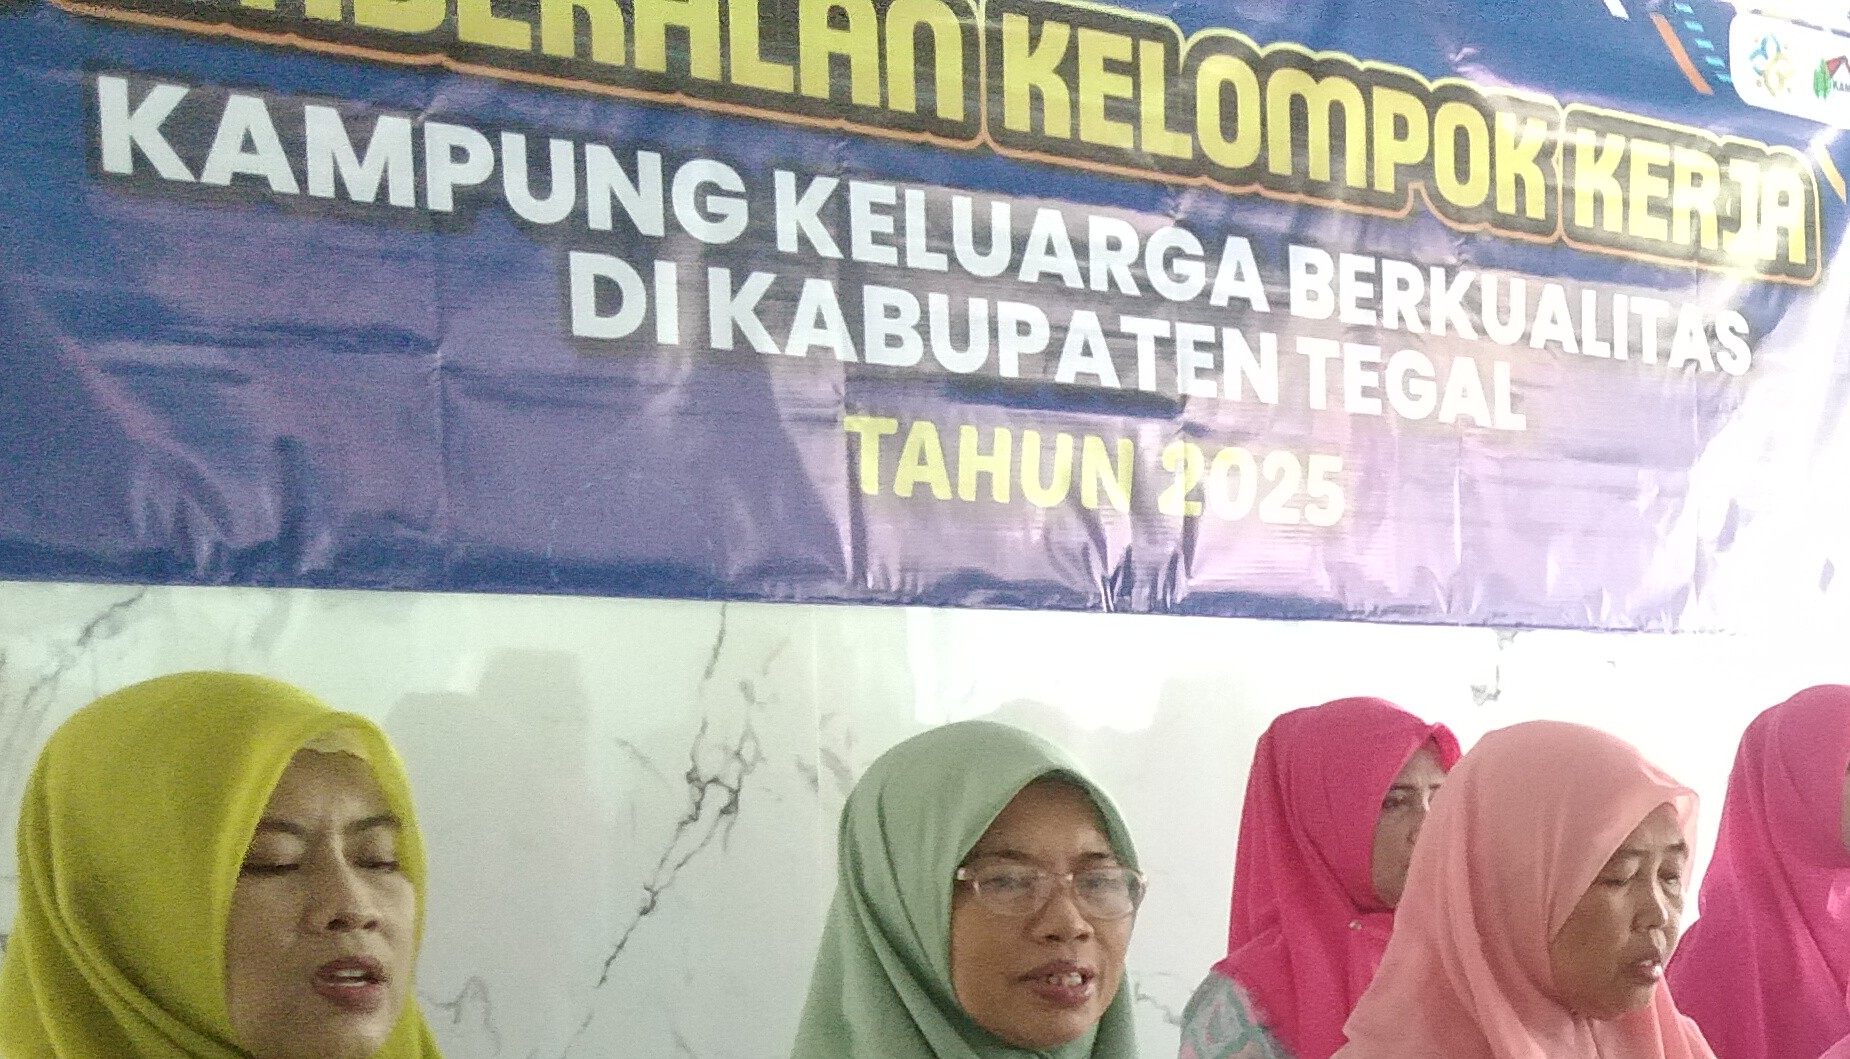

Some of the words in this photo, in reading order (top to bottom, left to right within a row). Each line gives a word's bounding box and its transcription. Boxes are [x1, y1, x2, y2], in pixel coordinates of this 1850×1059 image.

[95, 76, 748, 244] KAMPUNG
[773, 170, 1270, 314] KELUARGA
[1288, 246, 1753, 377] BERKUALITAS
[240, 0, 964, 122] KALAN
[1002, 13, 1549, 219] KELOMPOK
[1574, 130, 1807, 264] KERJA
[569, 251, 678, 346] DI
[707, 267, 1278, 405] KABUPATEN
[1296, 337, 1526, 431] TEGAL
[844, 415, 1135, 513] TAHUN
[1157, 439, 1345, 526] 2025
